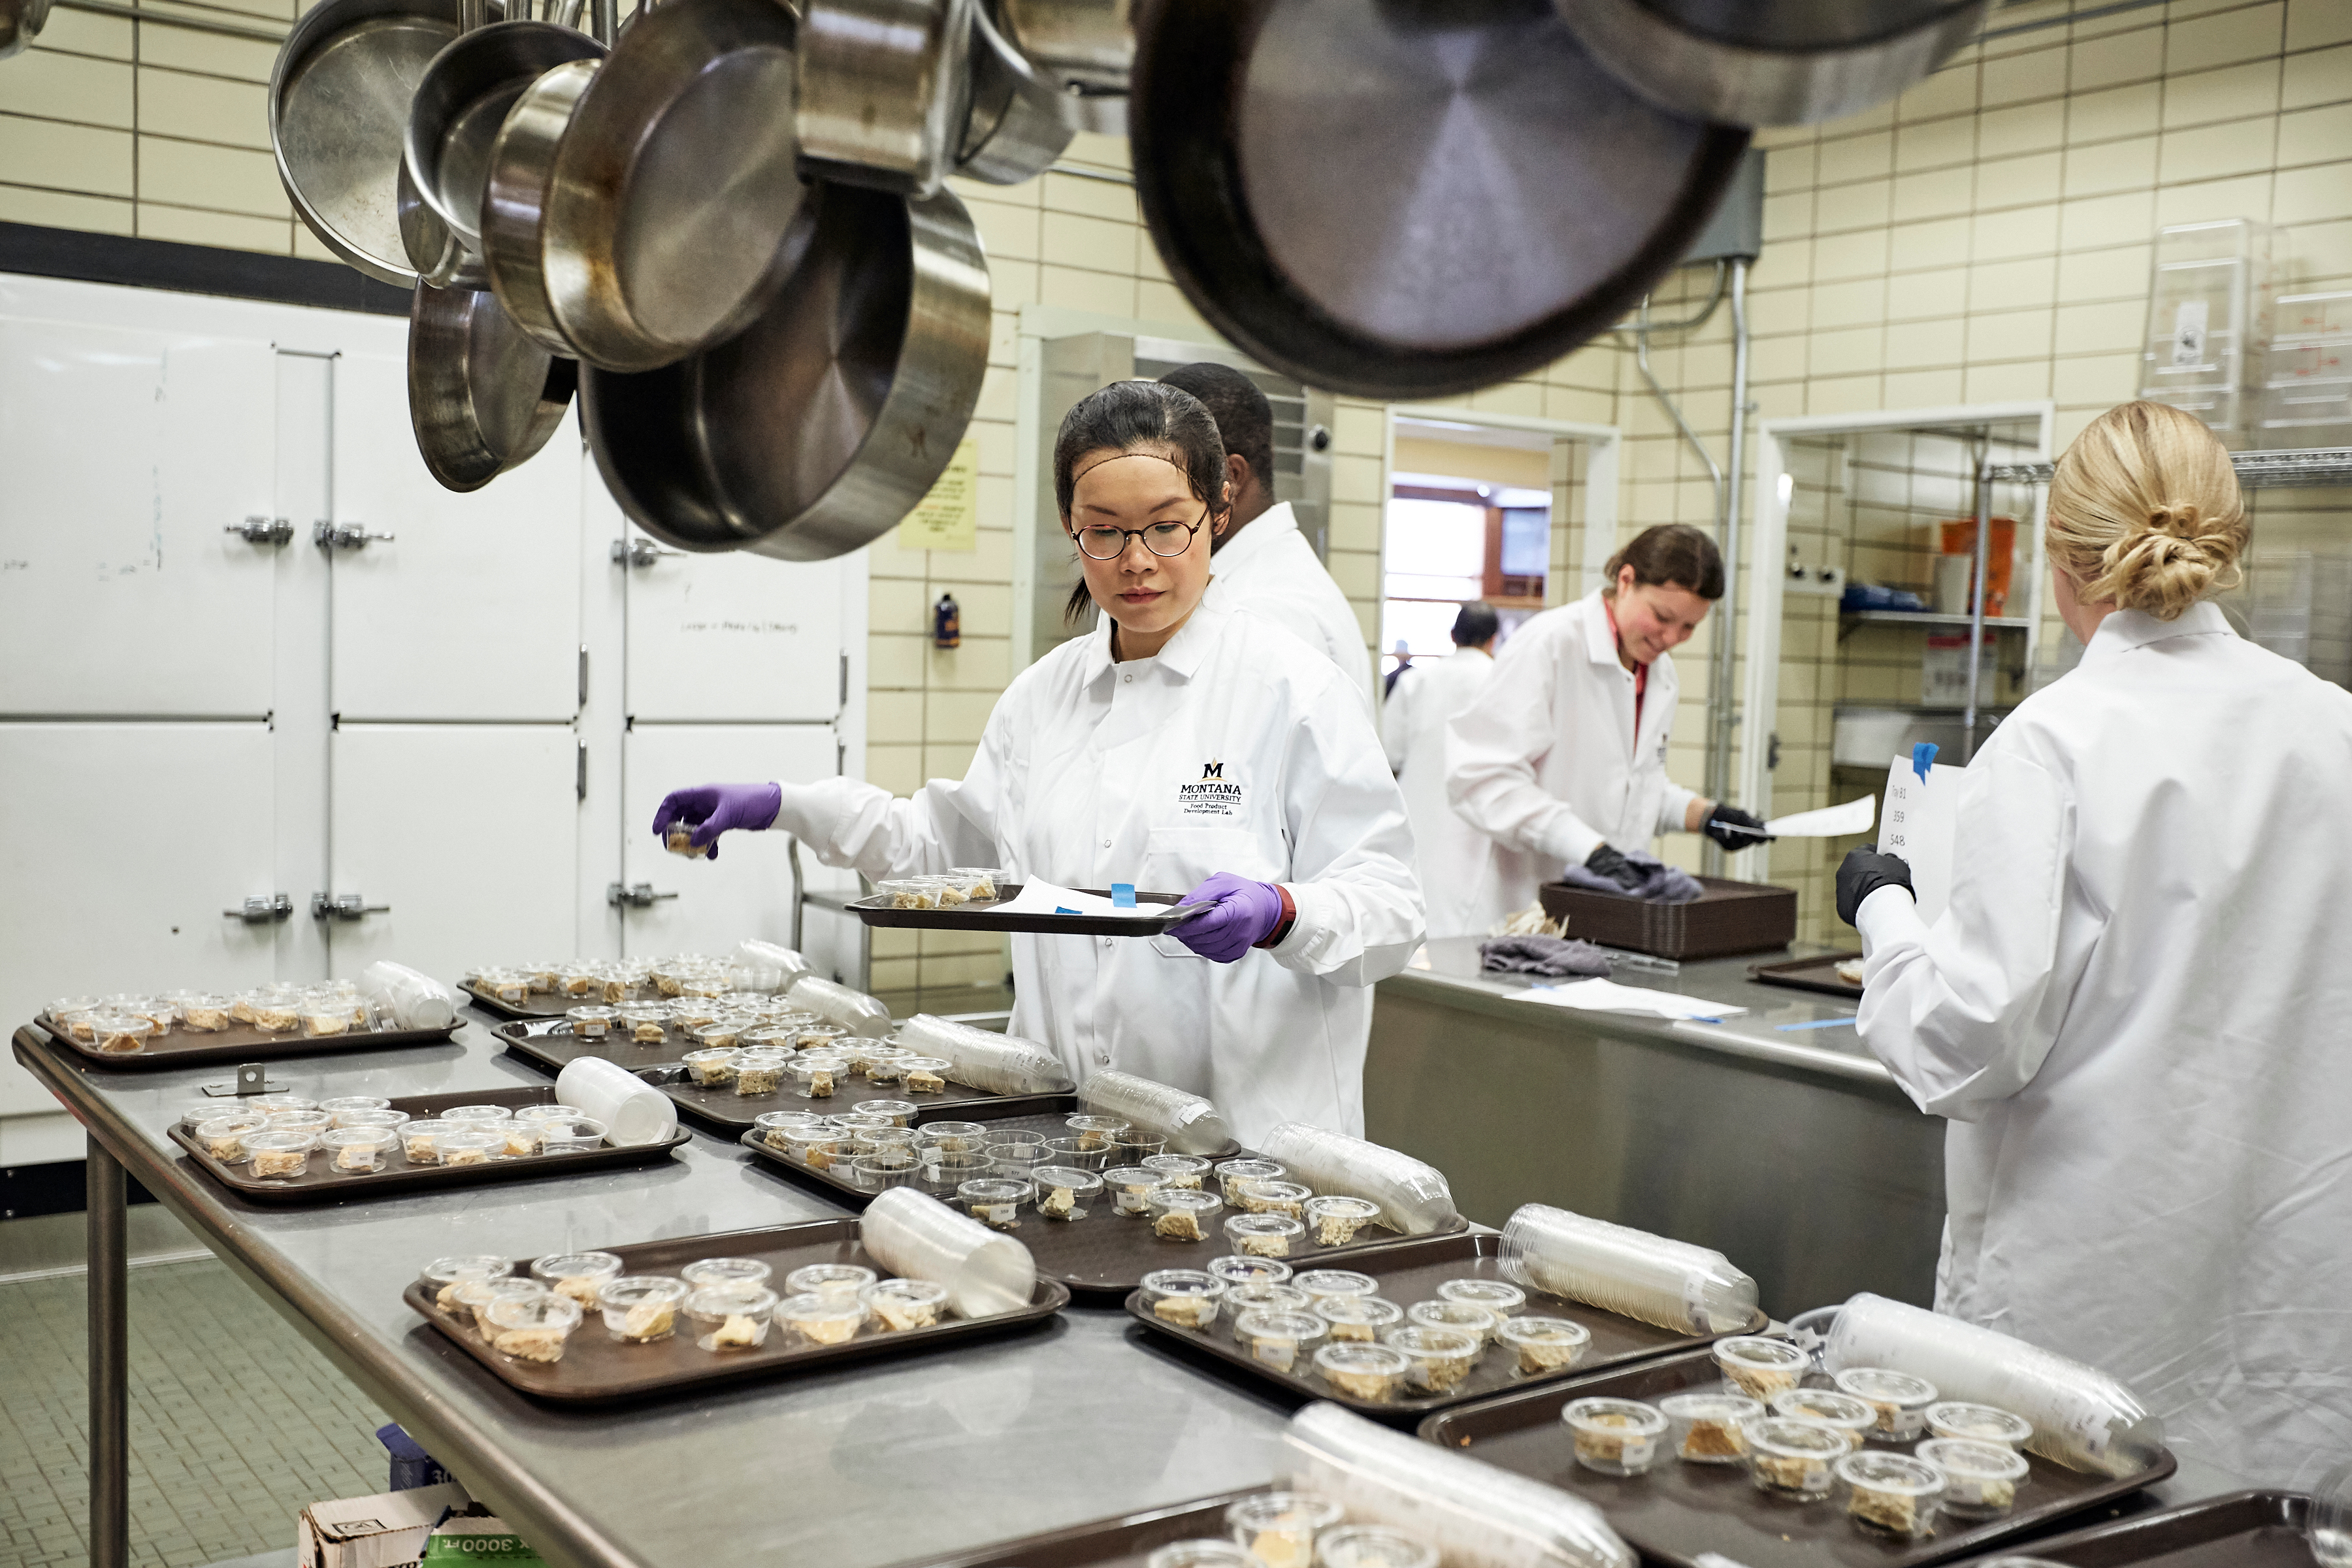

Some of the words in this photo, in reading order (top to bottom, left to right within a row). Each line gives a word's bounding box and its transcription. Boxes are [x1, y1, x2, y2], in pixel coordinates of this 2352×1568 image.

[1202, 763, 1224, 779] M
[1181, 784, 1241, 795] MONTANA
[1893, 811, 1904, 823] 359
[1890, 834, 1905, 846] 548
[442, 1539, 460, 1548] FT.
[462, 1539, 514, 1552] 3000
